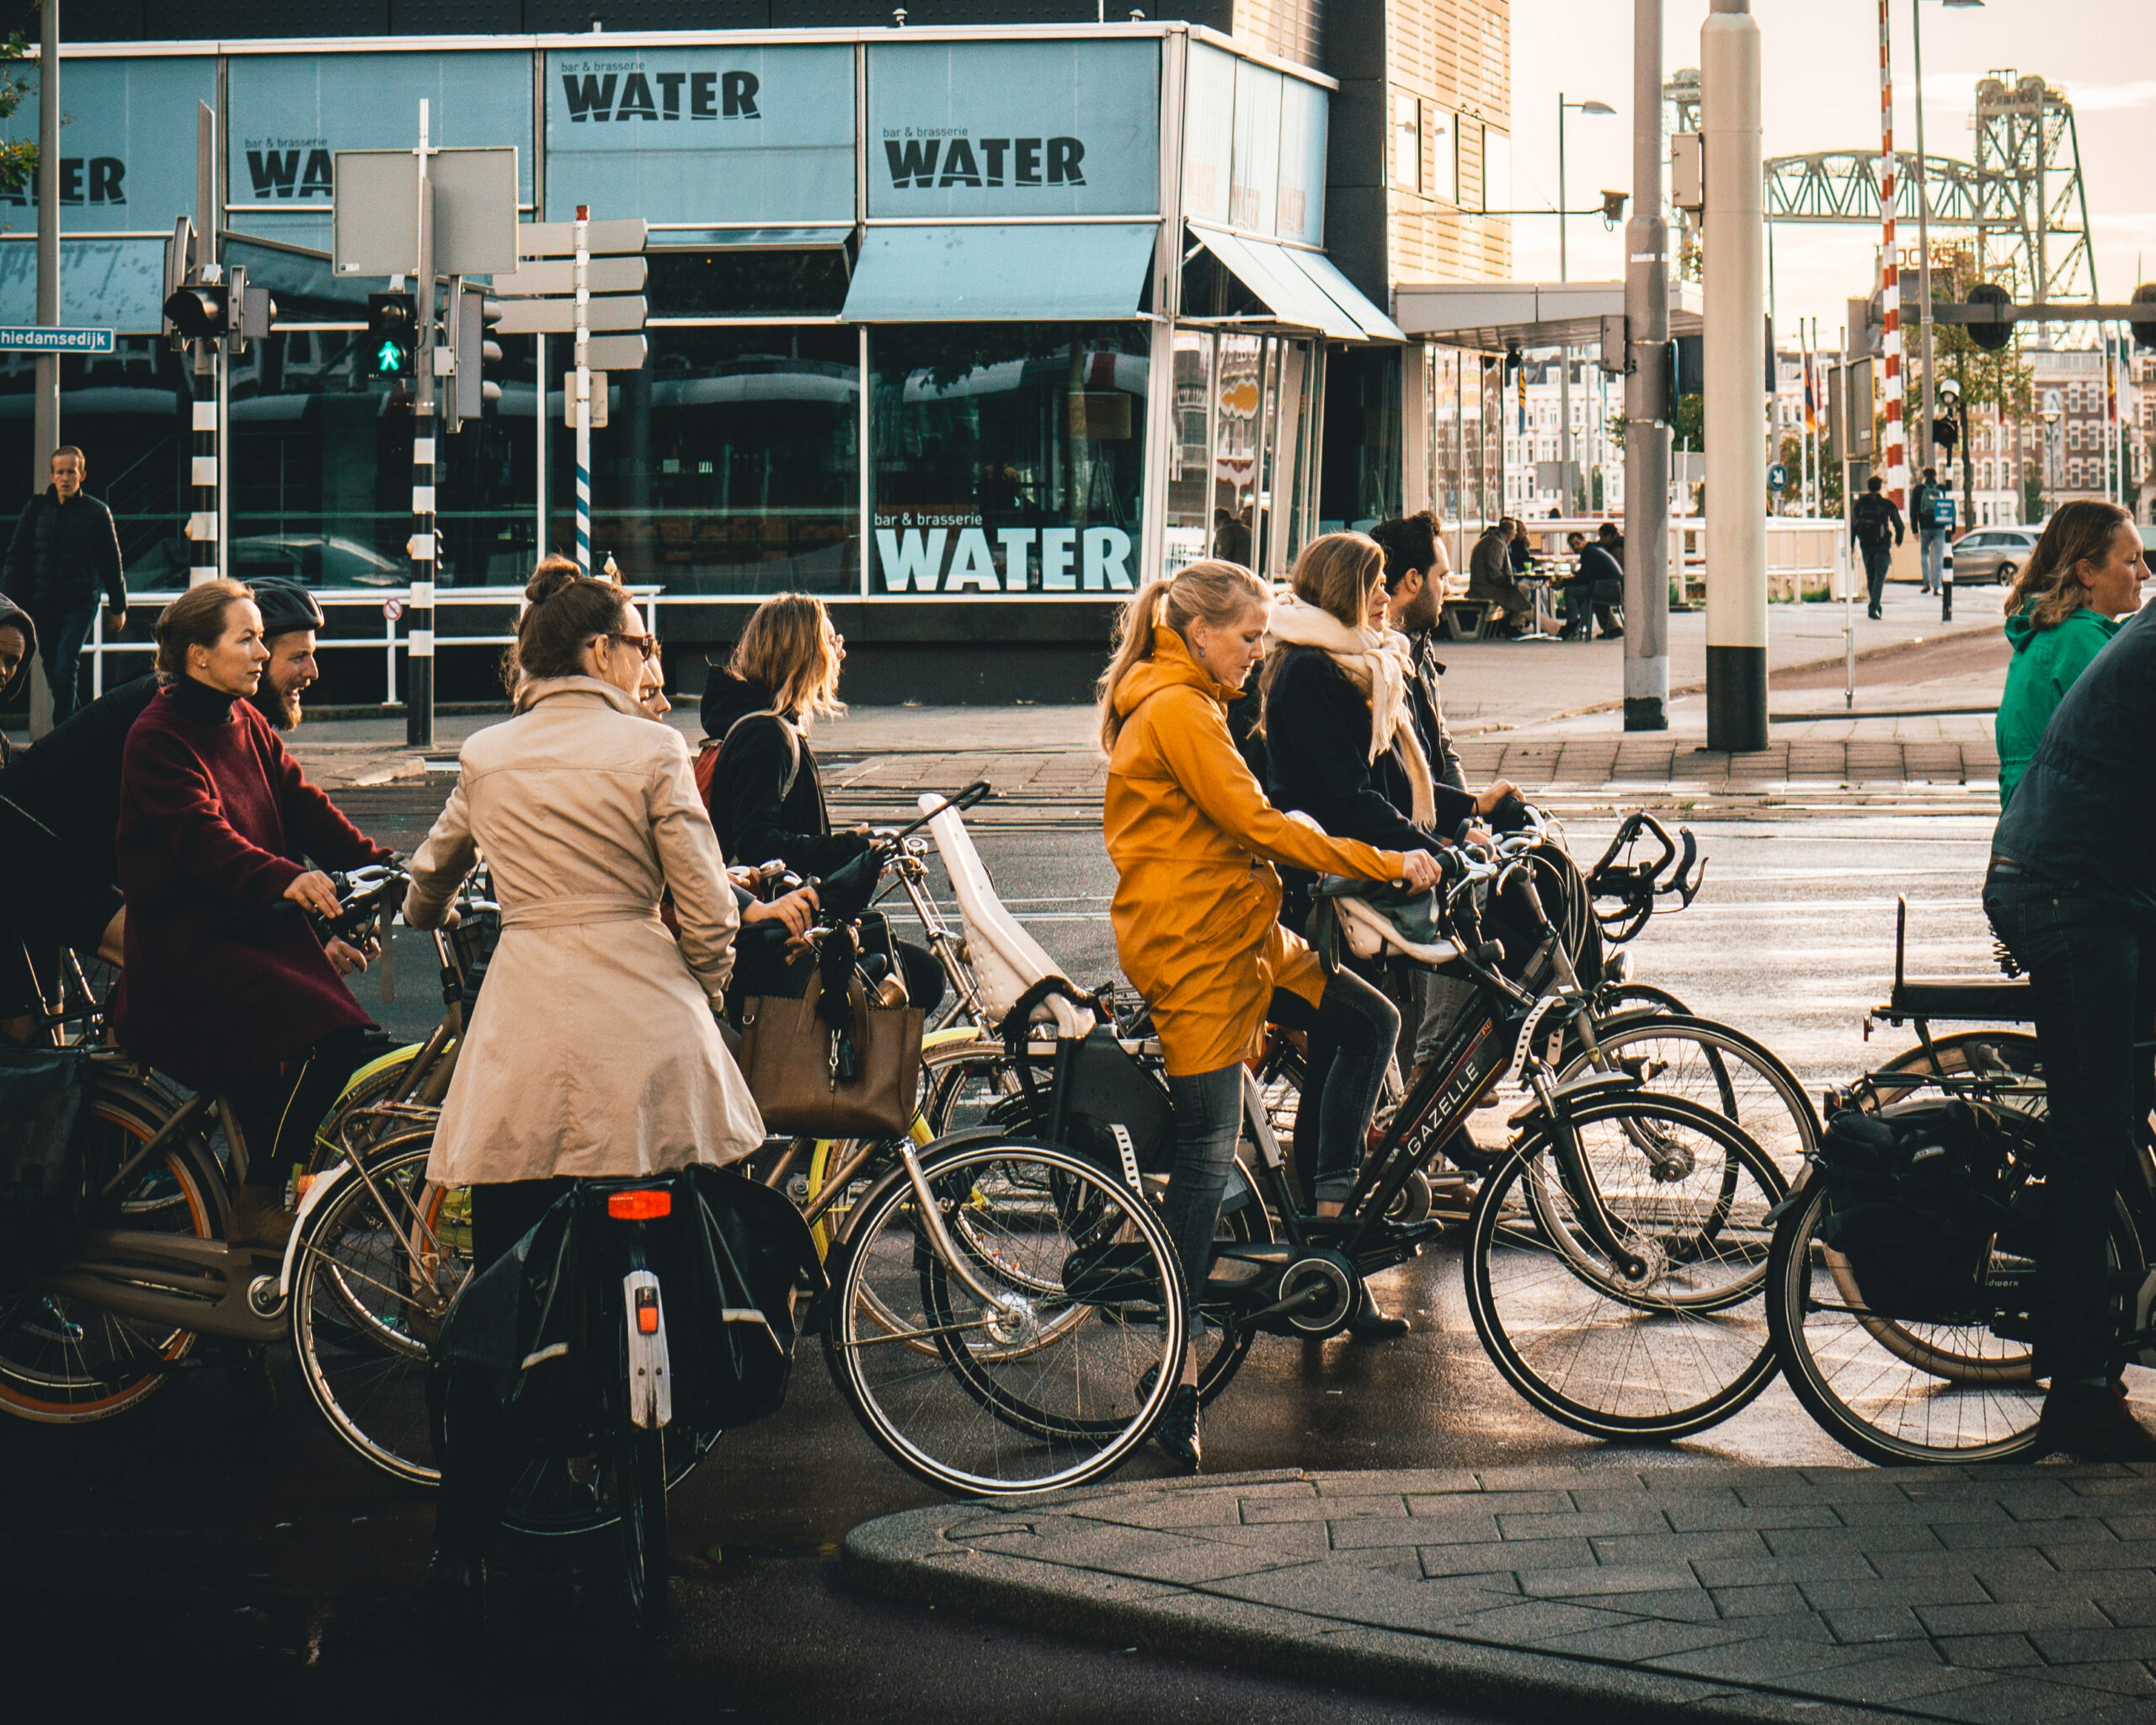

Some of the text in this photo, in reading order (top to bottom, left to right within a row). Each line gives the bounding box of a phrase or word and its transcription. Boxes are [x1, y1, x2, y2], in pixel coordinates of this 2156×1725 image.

[561, 60, 645, 72] bar & brasserie
[562, 70, 760, 123] WATER
[883, 126, 969, 138] bar & brasserie
[244, 137, 328, 149] bar & brasserie
[883, 136, 1087, 189] WATER
[1, 330, 106, 350] hiedamsedijk
[874, 511, 983, 526] bar & brasserie
[875, 526, 1134, 592] WATER
[1407, 1061, 1479, 1156] GAZELLE
